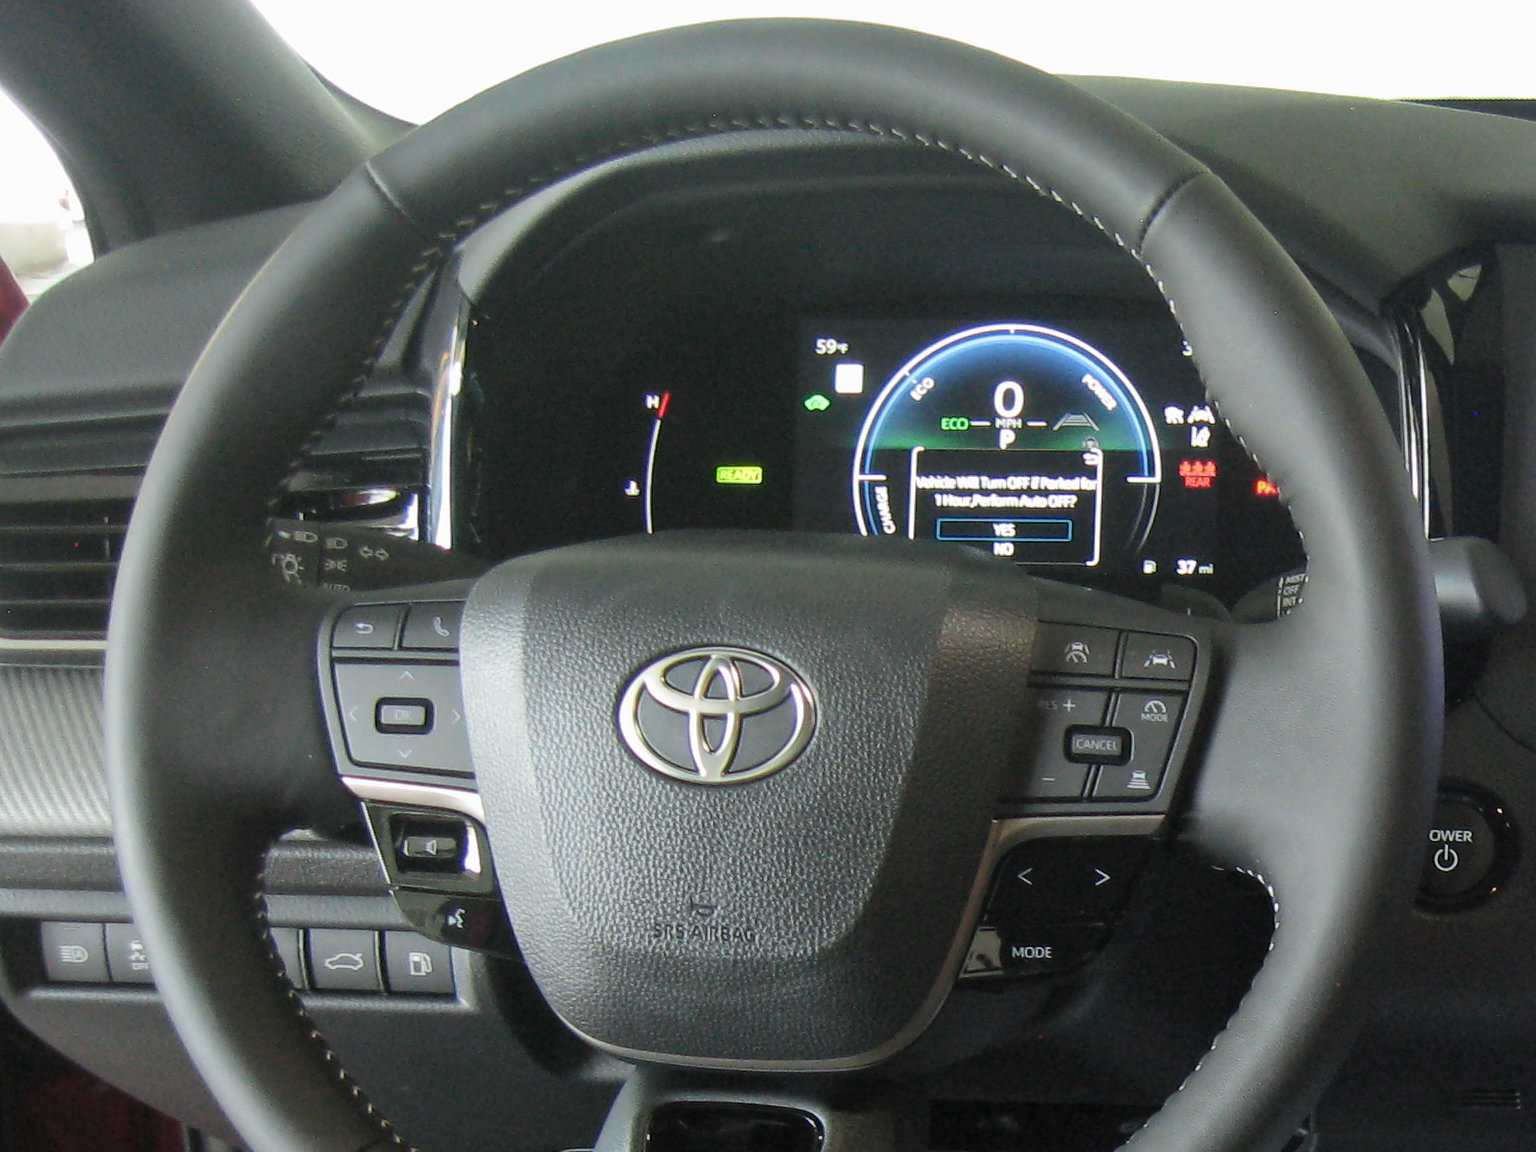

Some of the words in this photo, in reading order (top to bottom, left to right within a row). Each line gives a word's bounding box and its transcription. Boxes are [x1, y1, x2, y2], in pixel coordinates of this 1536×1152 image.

[909, 376, 936, 401] ECO
[1081, 373, 1118, 411] POWER
[994, 380, 1024, 418] 0
[941, 418, 969, 430] ECO
[995, 418, 1023, 429] MPH
[999, 429, 1016, 450] P
[916, 475, 956, 490] Vehicle
[980, 476, 1007, 490] Turn
[1007, 476, 1031, 490] OFF
[1040, 476, 1080, 490] Parked
[1185, 478, 1211, 487] REAR
[1020, 494, 1047, 508] Auto
[874, 486, 897, 535] CHARGE
[993, 523, 1016, 537] YES
[993, 543, 1015, 557] NO
[1176, 560, 1197, 575] 37
[1198, 564, 1214, 575] mi
[1141, 713, 1168, 723] MODE
[1075, 738, 1119, 751] CANCEL
[1428, 829, 1473, 844] OWER
[654, 924, 685, 939] SRS
[691, 925, 756, 942] AIRBAG
[1011, 946, 1052, 960] MODE
